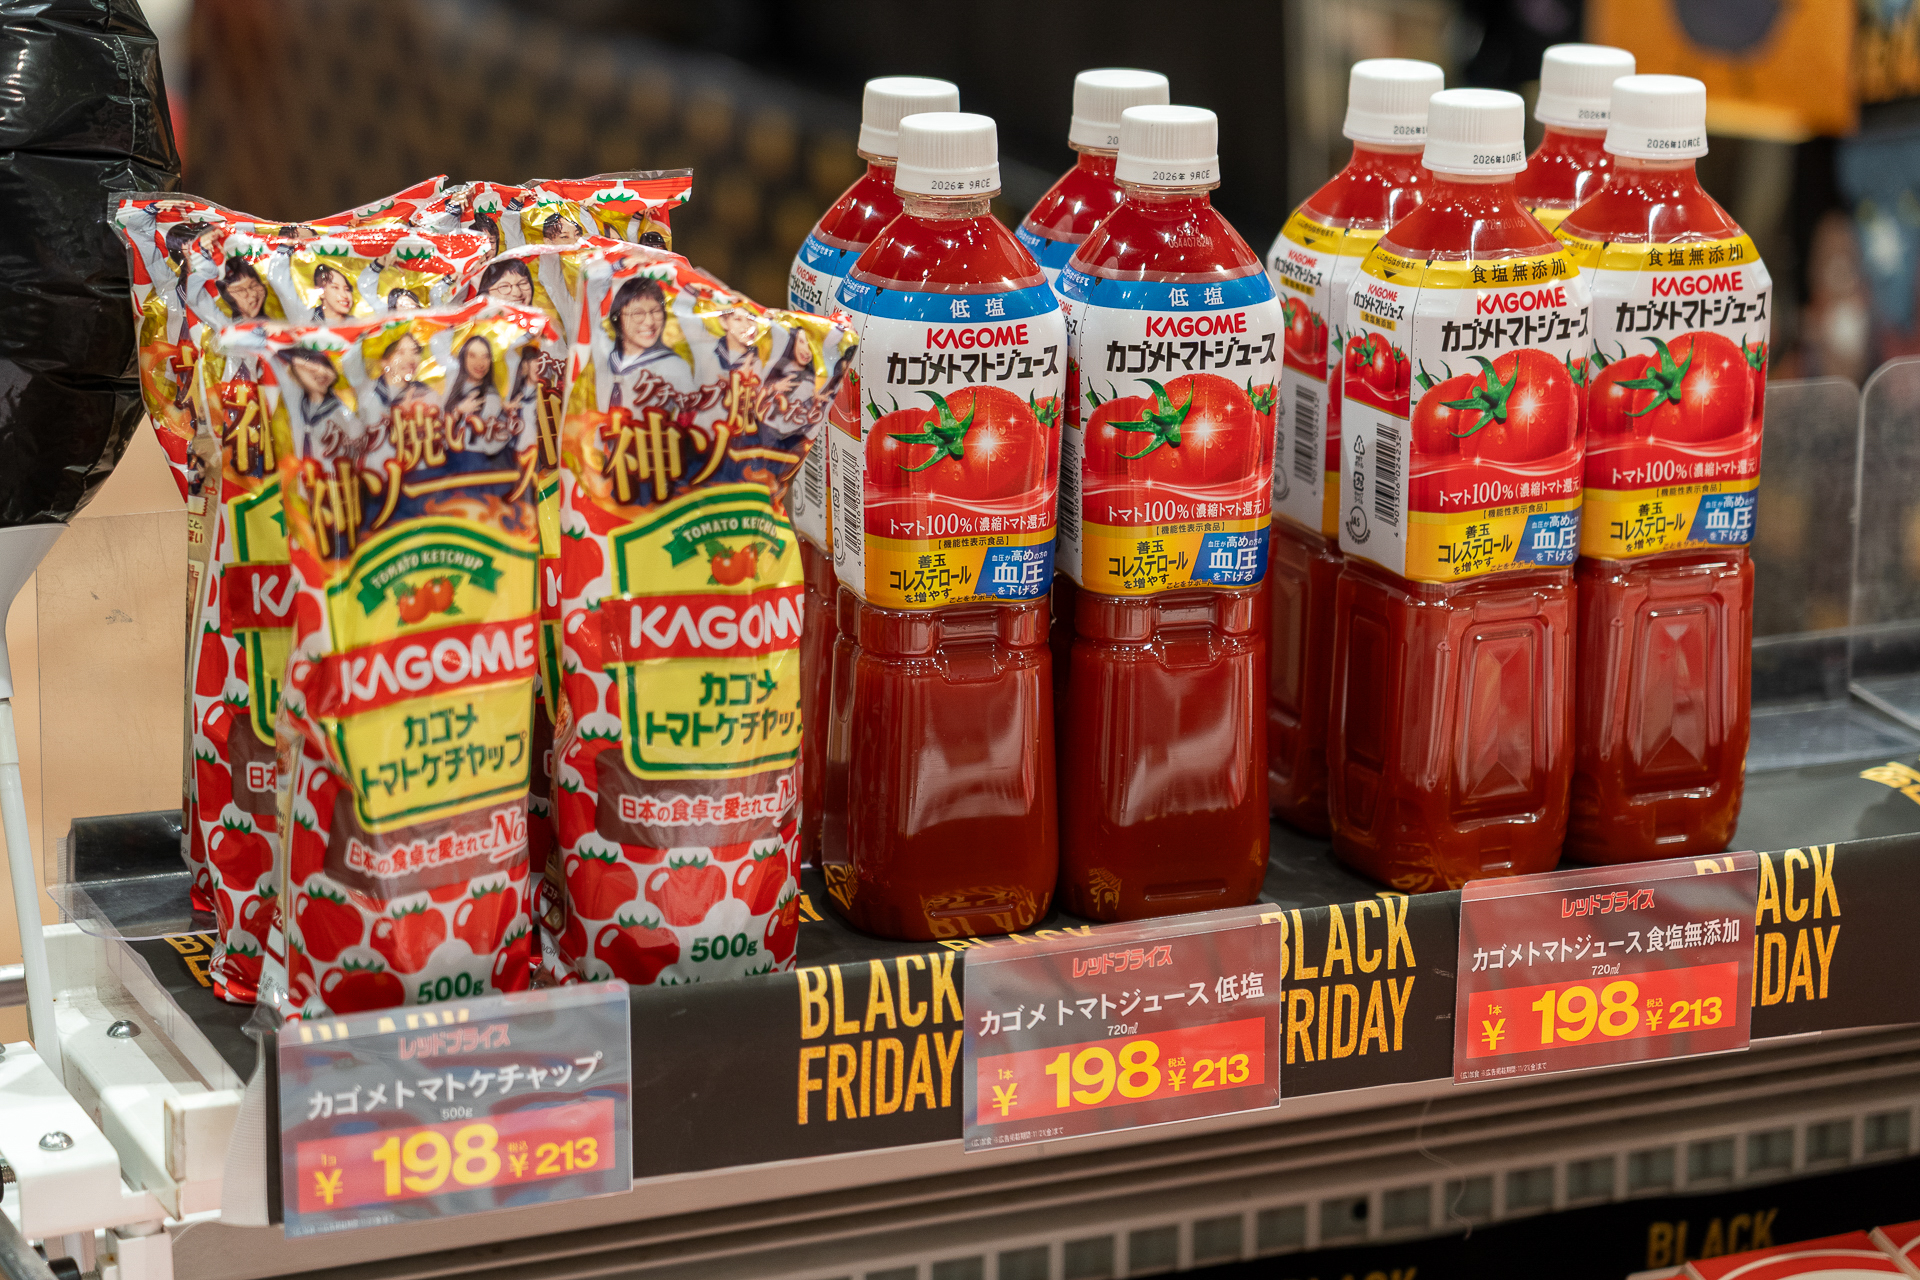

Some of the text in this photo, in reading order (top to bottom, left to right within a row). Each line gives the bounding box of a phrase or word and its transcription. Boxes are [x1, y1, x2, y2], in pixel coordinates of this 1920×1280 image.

[1473, 152, 1522, 164] 2026年10月CE
[1288, 250, 1319, 268] KAGOME
[1647, 243, 1744, 267] 食塩無添加
[1470, 258, 1566, 284] 食塩無添加
[1652, 271, 1744, 297] KAGOME
[1168, 287, 1225, 308] 低塩
[1353, 290, 1405, 321] カゴメトマトジュース
[1367, 283, 1399, 302] KAGOME
[1477, 286, 1567, 316] KAGOME
[950, 297, 1006, 319] 低塩
[1615, 291, 1767, 333] カゴメトマトジュース
[926, 324, 1029, 350] KAGOME
[1146, 312, 1247, 338] KAGOME
[1441, 307, 1589, 352] カゴメトマトジュース
[886, 345, 1059, 386] カゴメトマトジュース
[1106, 333, 1277, 374] カゴメトマトジュース
[1638, 501, 1663, 517] 善玉
[1705, 506, 1752, 530] 血圧
[683, 517, 739, 542] TOMATO
[1465, 523, 1490, 538] 善玉
[1531, 525, 1577, 550] 血圧
[1610, 513, 1686, 541] コレステロール
[1709, 529, 1748, 542] を下げる
[1136, 540, 1164, 554] 善玉
[1438, 534, 1513, 564] コレステロール
[1536, 550, 1574, 562] を下げる
[1626, 535, 1667, 553] を増やす
[370, 549, 484, 589] TOMATO KETCHUP
[918, 553, 946, 569] 善玉
[1108, 552, 1189, 578] コレステロール
[1209, 546, 1258, 570] 血圧
[1453, 556, 1494, 575] を増やす
[889, 566, 972, 592] コレステロール
[992, 560, 1044, 585] 血圧
[1124, 573, 1170, 589] を増やす
[1213, 570, 1253, 582] を下げる
[904, 588, 952, 604] を増やす
[997, 584, 1039, 596] を下げる
[340, 623, 536, 704] KAGOME
[698, 669, 778, 707] カゴメ
[403, 702, 478, 751] カゴメ
[645, 702, 803, 747] トマトケチャッ
[359, 731, 528, 798] トマトケチャップ
[1561, 888, 1655, 918] レッドプライス
[690, 932, 759, 964] 500g
[1073, 945, 1173, 978] レッドプライス
[417, 972, 485, 1006] 500g
[797, 951, 964, 1040] BLACK
[1488, 1003, 1502, 1016] 1本
[1532, 980, 1640, 1044] 198
[1646, 997, 1664, 1008] 税込
[1281, 976, 1416, 1064] RIDAY
[997, 1068, 1014, 1081] 1本
[1045, 1039, 1162, 1109] 198
[1168, 1056, 1187, 1068] 税込
[307, 1051, 603, 1120] カゴメトマトケチャップ
[798, 1030, 963, 1125] FRIDAY
[441, 1106, 473, 1121] 500g
[373, 1123, 502, 1196] 198
